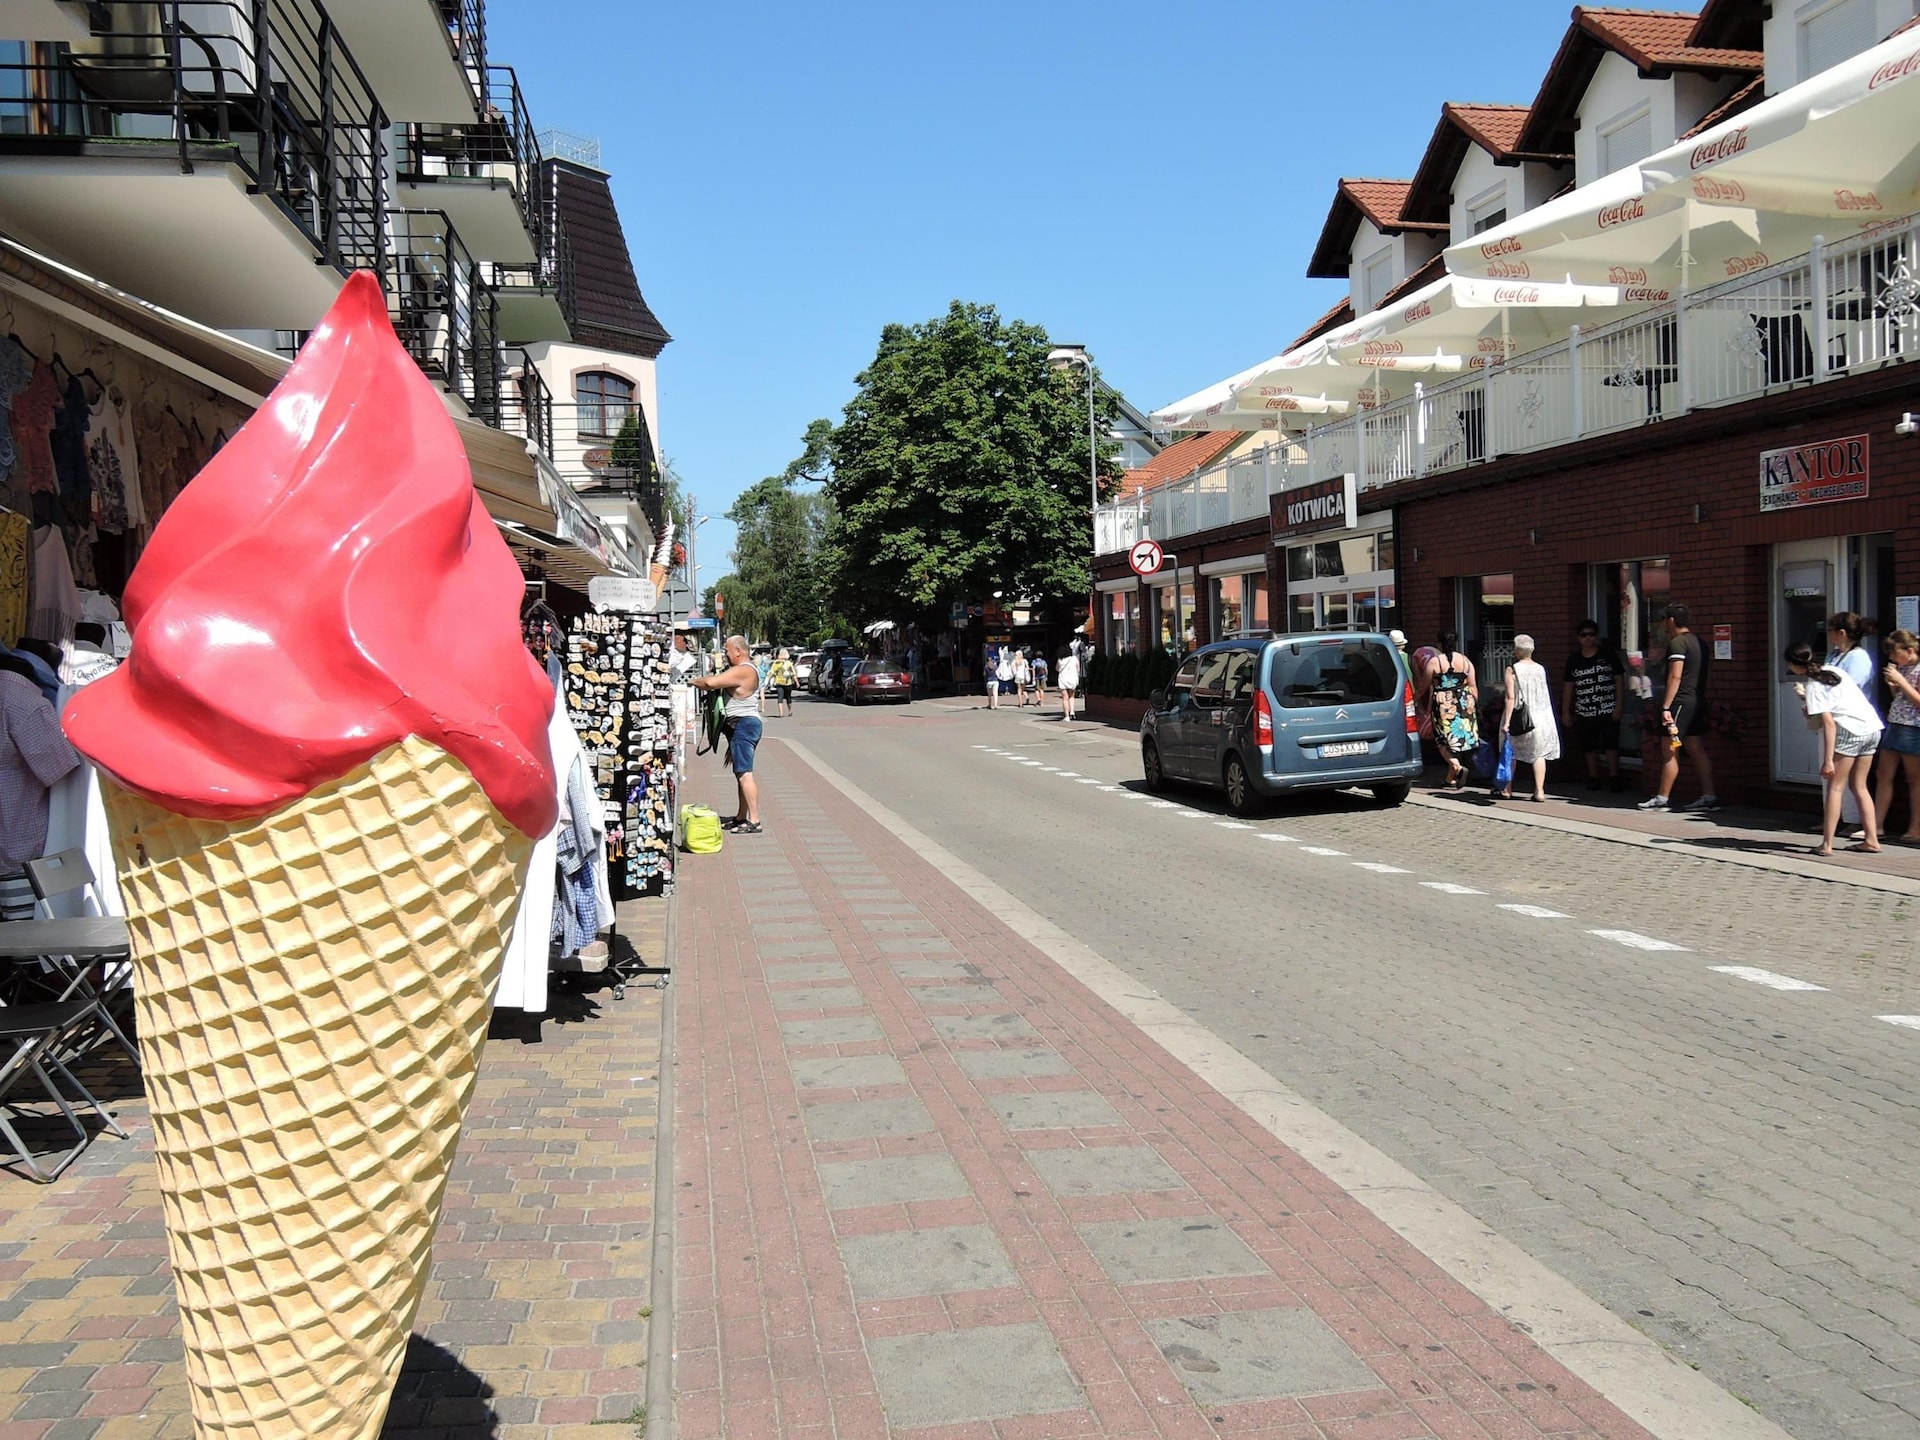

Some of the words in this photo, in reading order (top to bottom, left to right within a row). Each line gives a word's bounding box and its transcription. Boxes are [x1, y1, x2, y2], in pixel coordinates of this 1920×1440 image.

[1691, 126, 1749, 169] Coca-Cola
[1598, 196, 1646, 228] Coca-Cola
[1481, 235, 1522, 259] Coca-Cola
[1494, 286, 1539, 303] Coca-Cola
[1625, 288, 1669, 301] Coca-Cola
[1405, 300, 1431, 323] Coca-Cola
[1266, 399, 1298, 410] Coca-Cola
[1764, 440, 1864, 487] KANTOR
[1764, 491, 1799, 505] EXCHANGE
[1808, 481, 1864, 499] WECHSELSTUBE
[1287, 493, 1344, 525] KOTWICA
